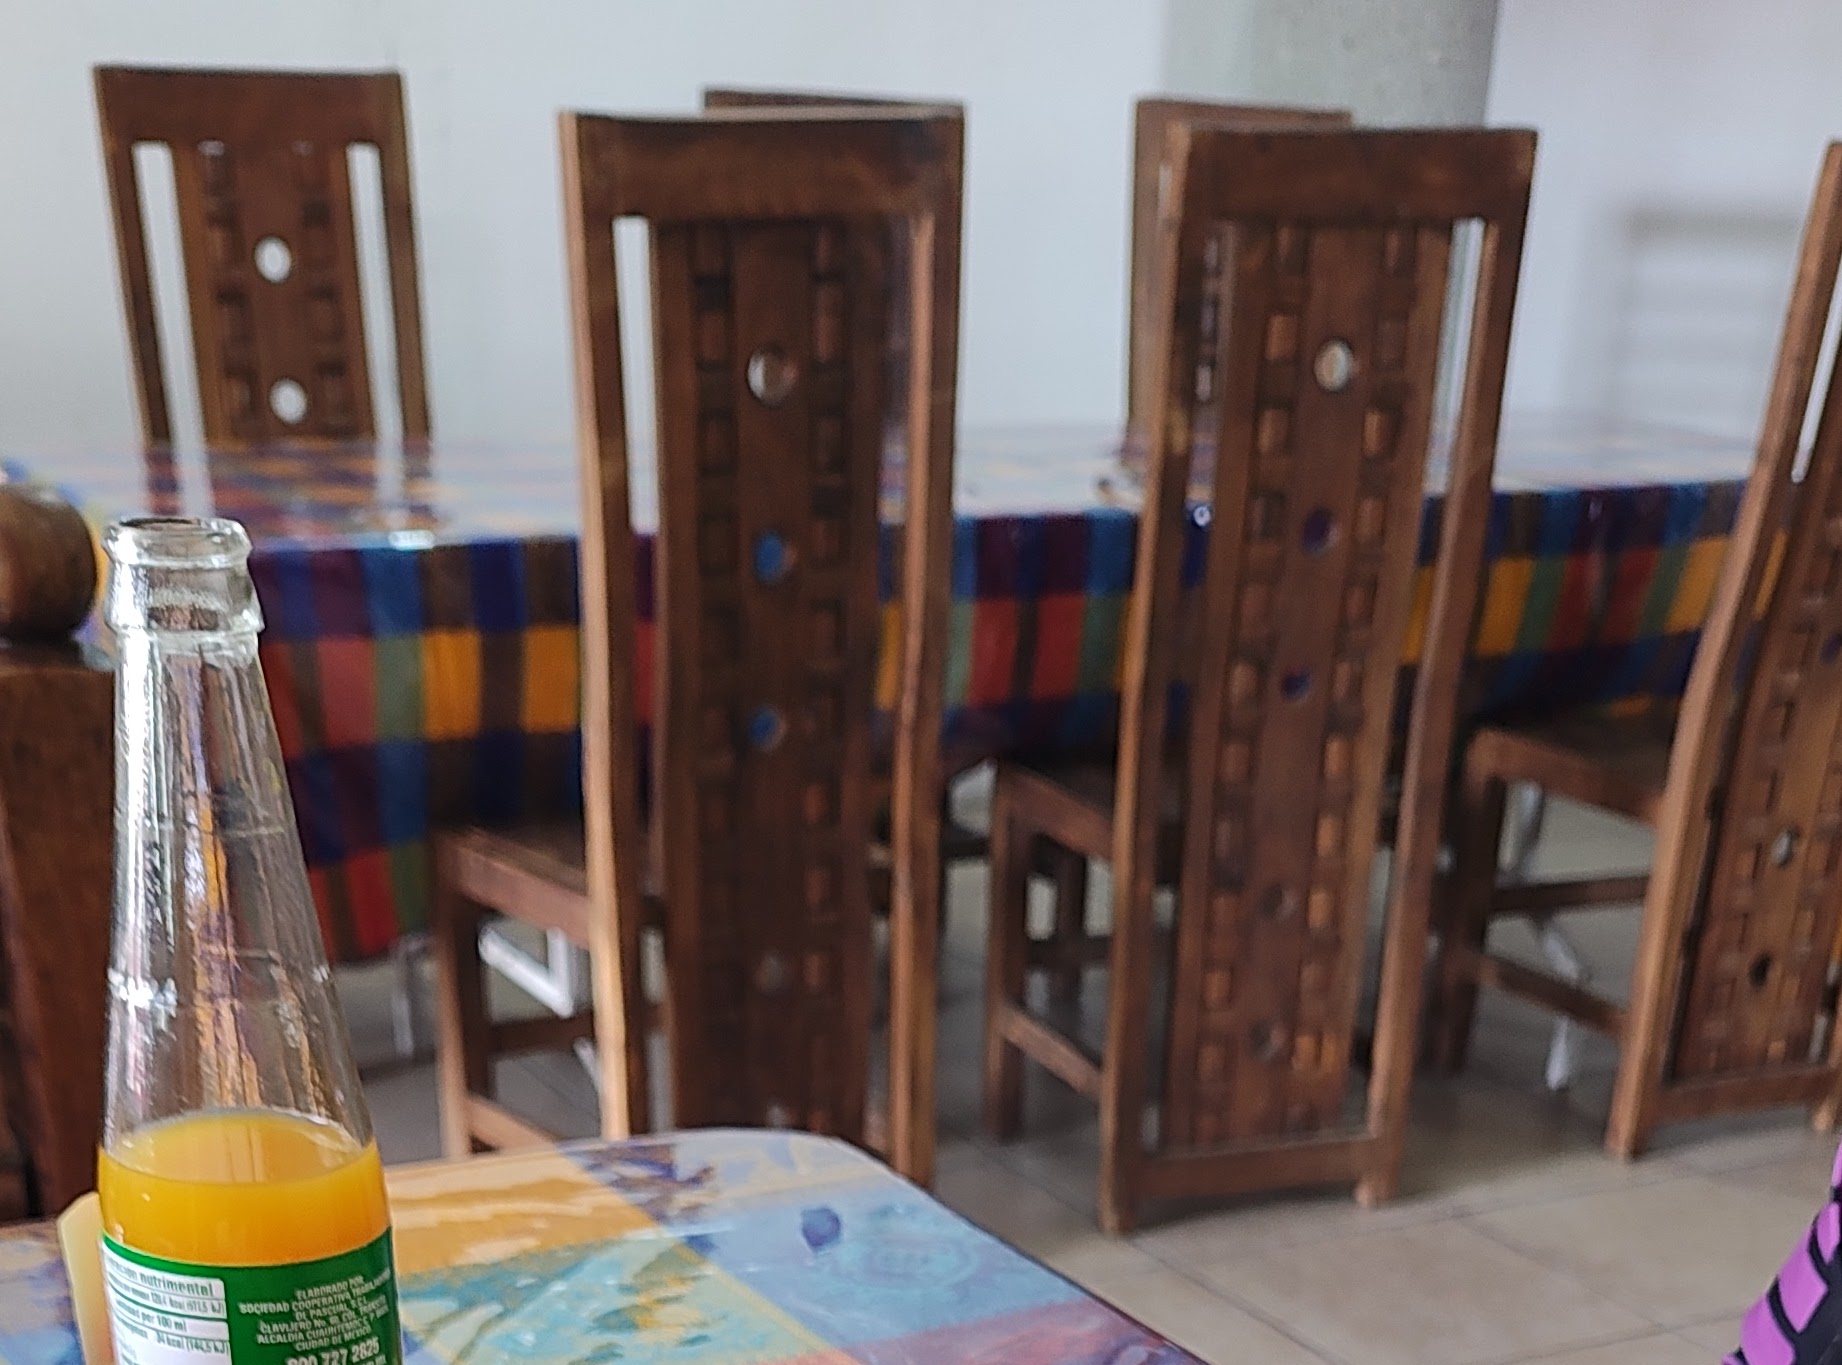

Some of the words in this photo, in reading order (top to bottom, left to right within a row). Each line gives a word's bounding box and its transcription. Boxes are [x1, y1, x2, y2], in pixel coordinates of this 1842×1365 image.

[139, 1272, 213, 1297] nutrimental
[238, 1301, 290, 1315] SOCIEDAD
[291, 1291, 351, 1311] COOPERATIVA
[156, 1315, 172, 1328] 100
[174, 1320, 187, 1332] ml
[259, 1320, 312, 1334] CLAVIJERO
[294, 1337, 330, 1352] CIUDAD
[351, 1336, 380, 1363] 2825
